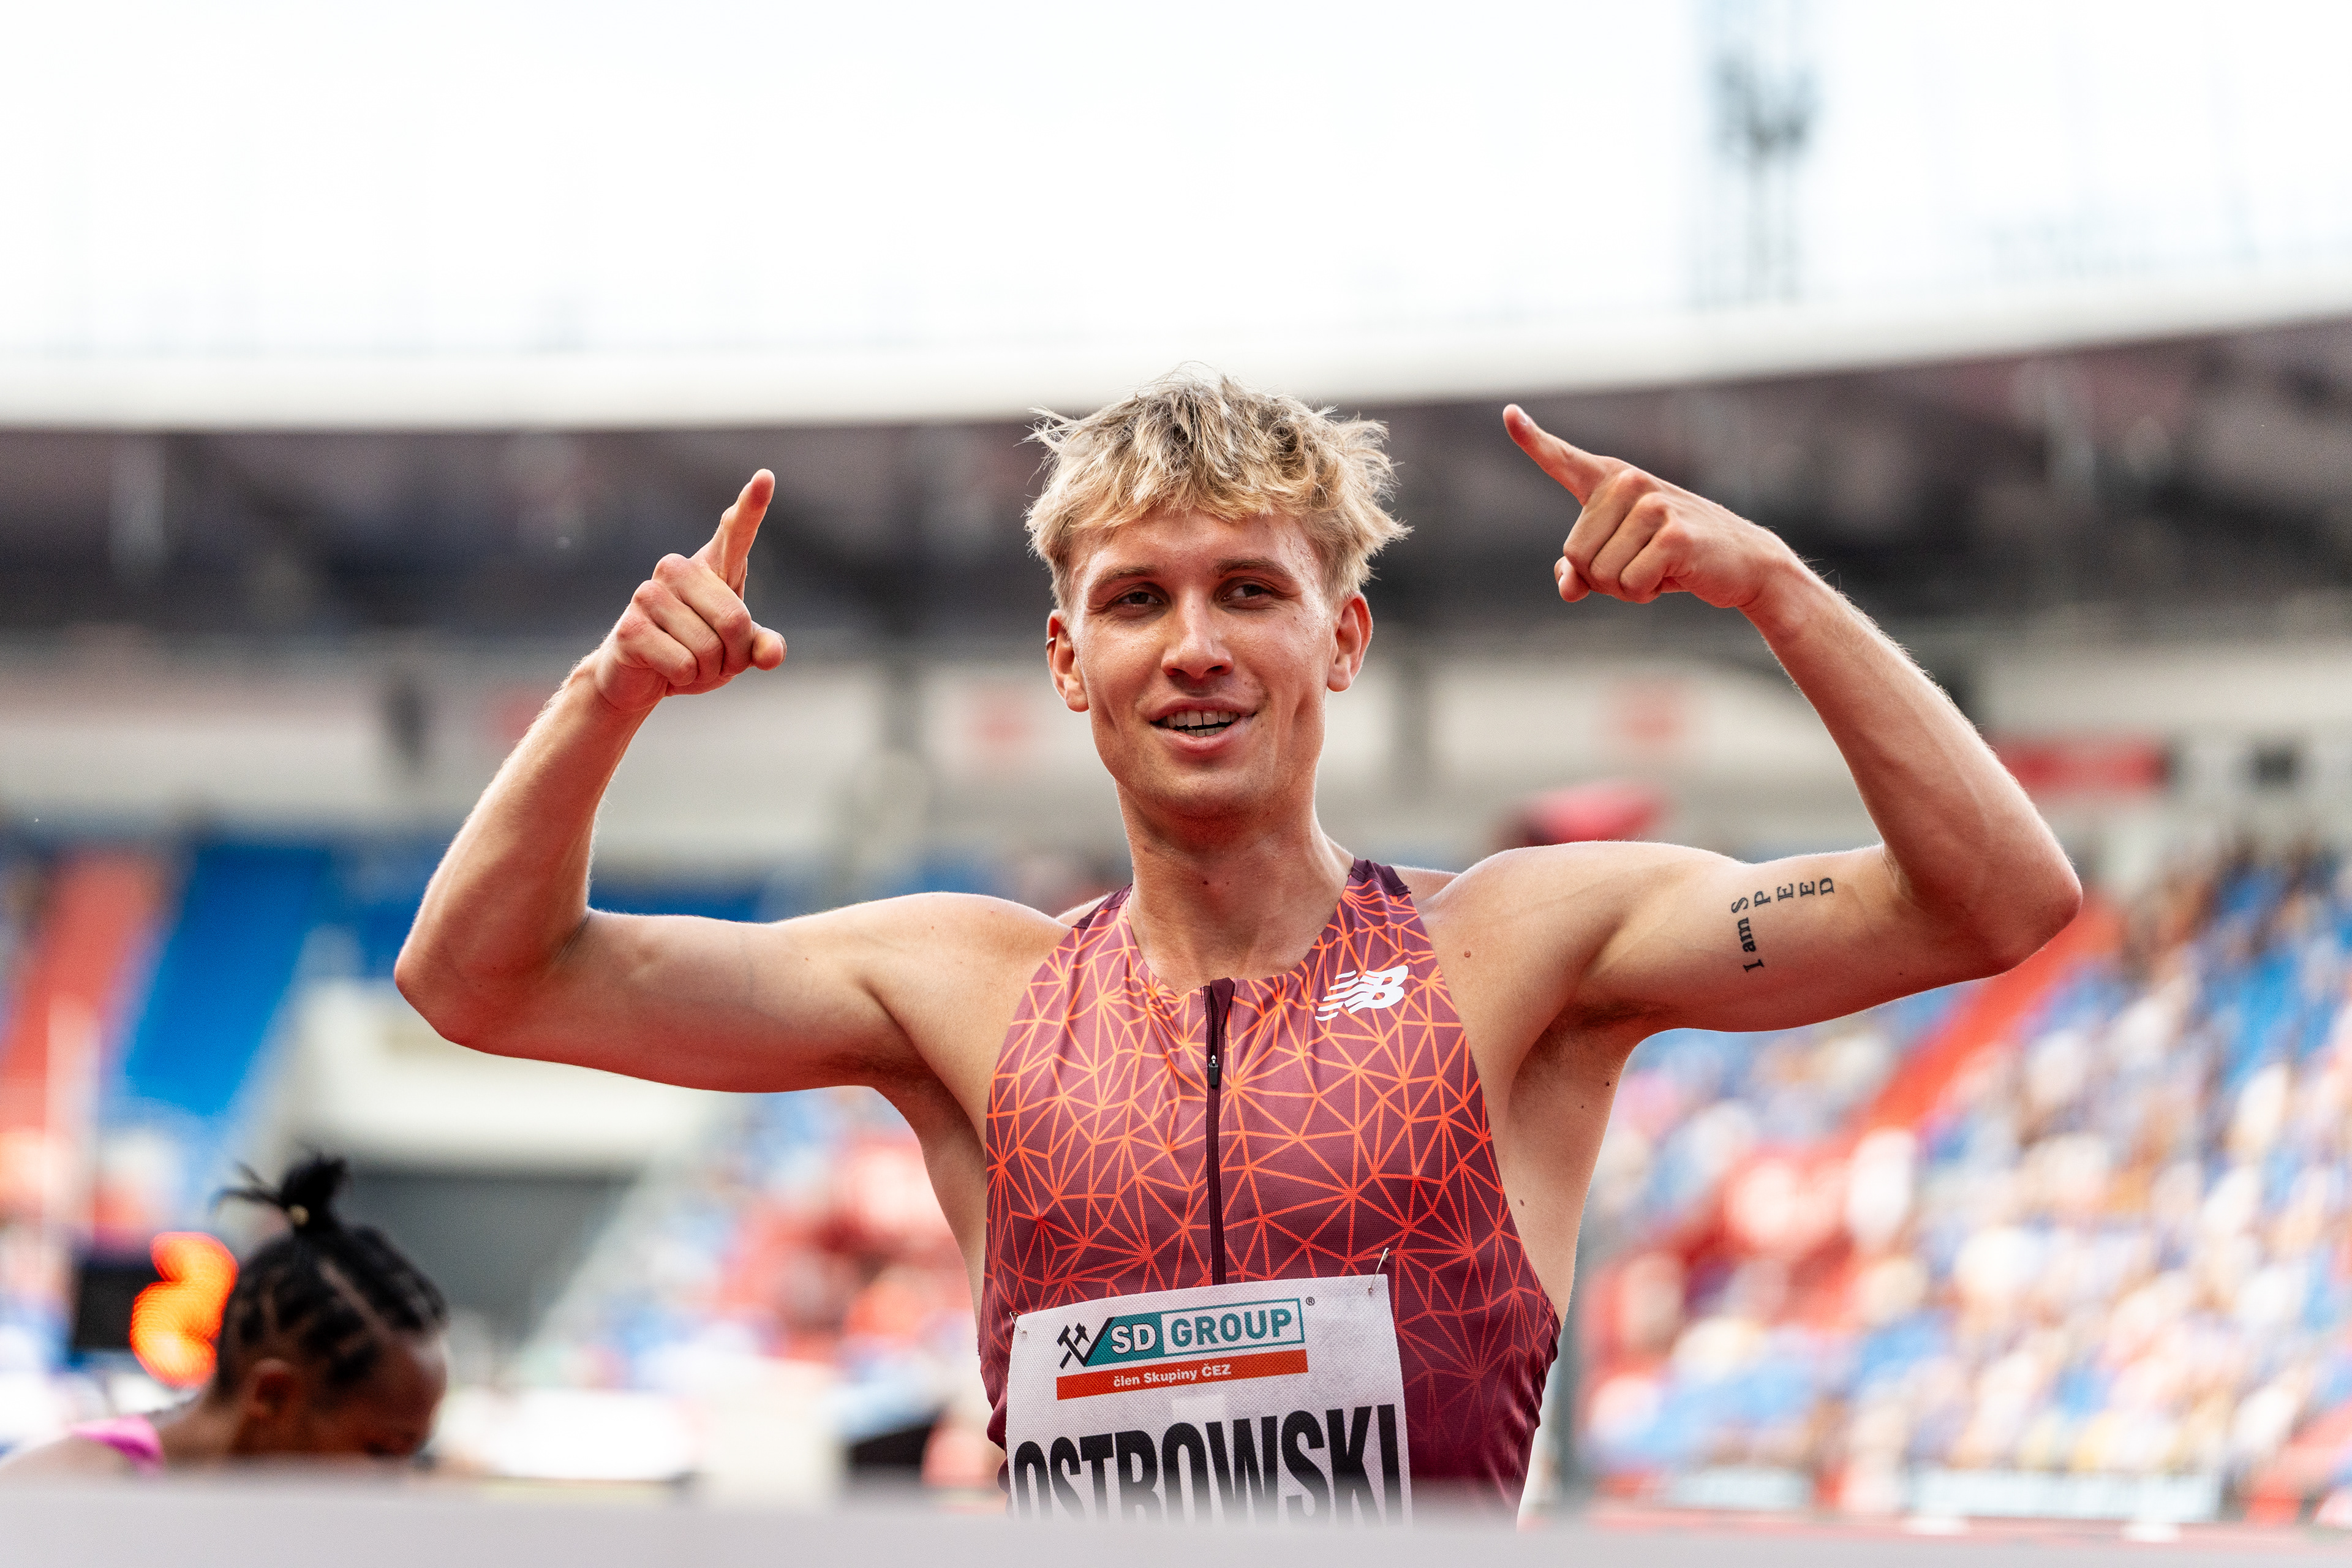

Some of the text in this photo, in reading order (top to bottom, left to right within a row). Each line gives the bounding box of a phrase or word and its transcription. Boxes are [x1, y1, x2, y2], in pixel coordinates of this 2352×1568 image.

[1731, 877, 1835, 973] I am SPEED
[1110, 1308, 1292, 1355] SD GROUP
[1114, 1363, 1232, 1388] člen Skupiny ČEZ
[1014, 1403, 1403, 1528] OSTROWSKI
